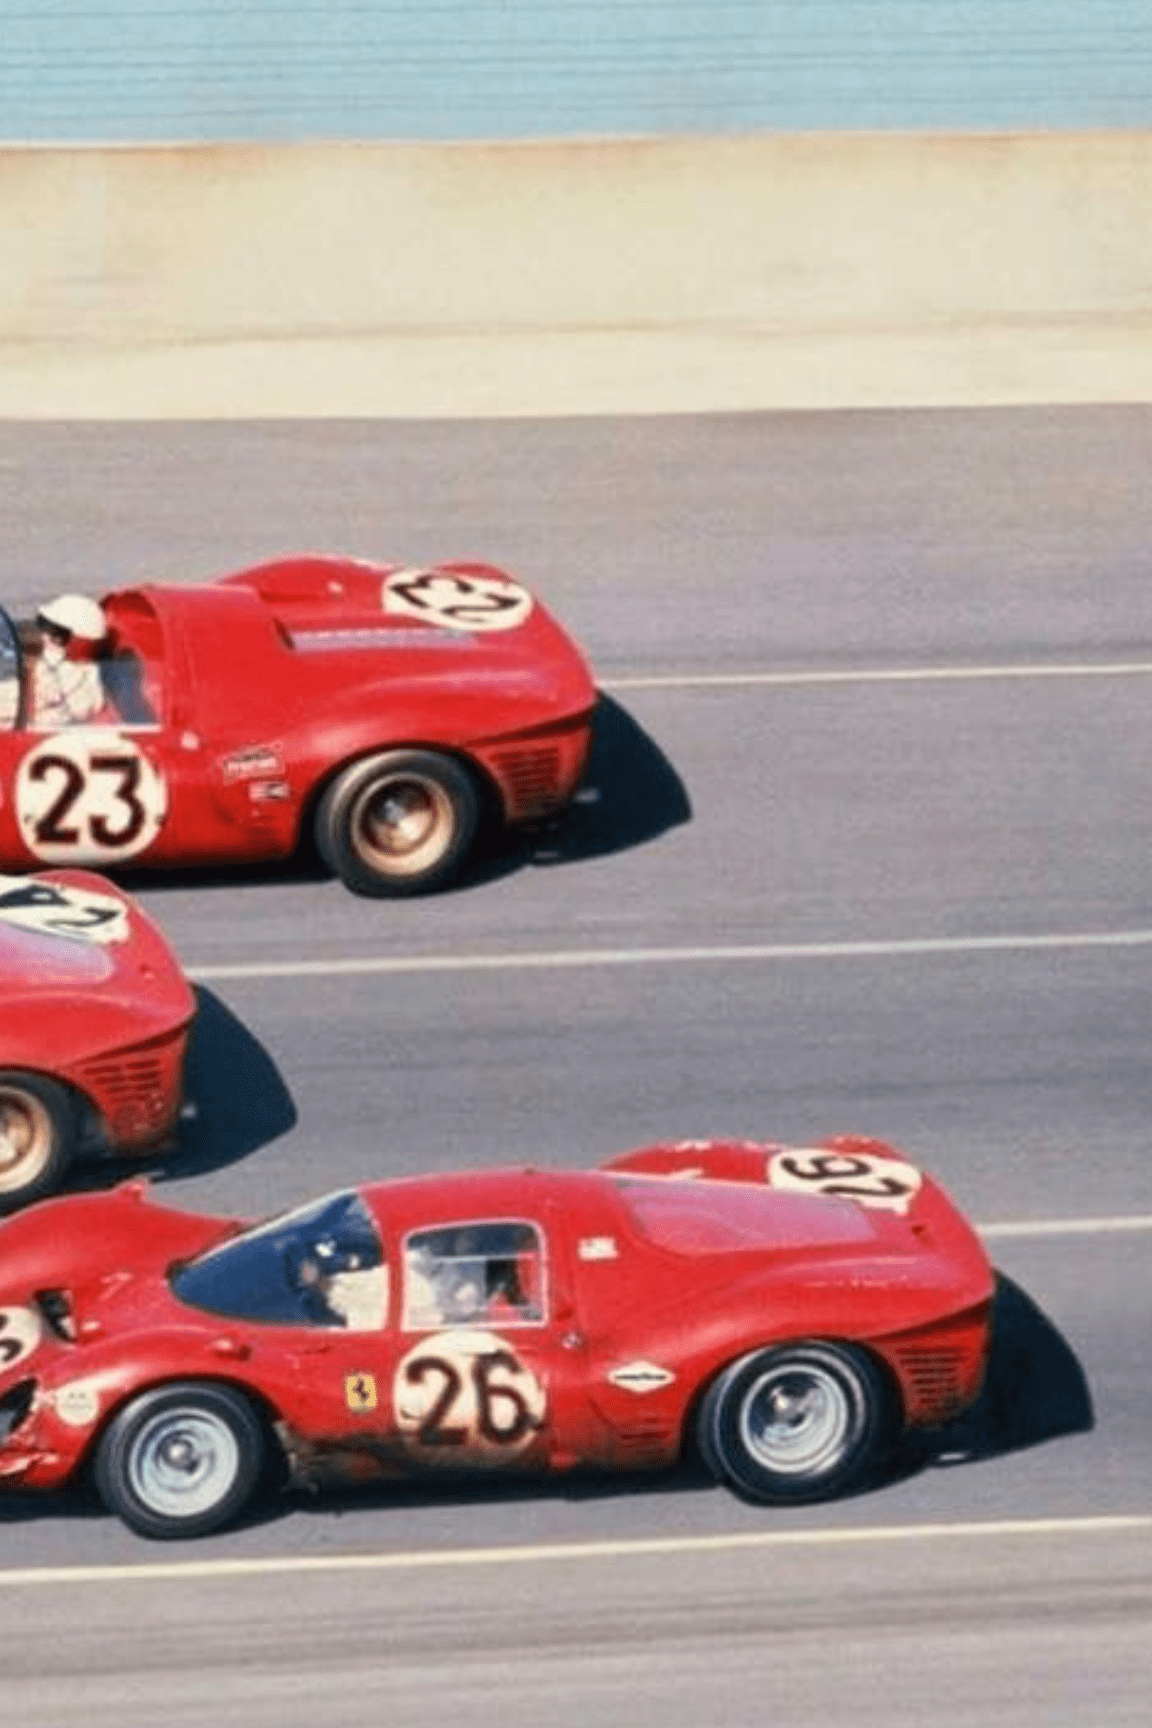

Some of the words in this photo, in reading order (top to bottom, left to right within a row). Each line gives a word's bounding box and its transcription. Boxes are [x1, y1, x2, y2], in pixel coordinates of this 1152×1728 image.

[389, 574, 522, 623] 23
[29, 754, 146, 848] 23
[780, 1155, 912, 1197] 26
[406, 1349, 522, 1446] 26
